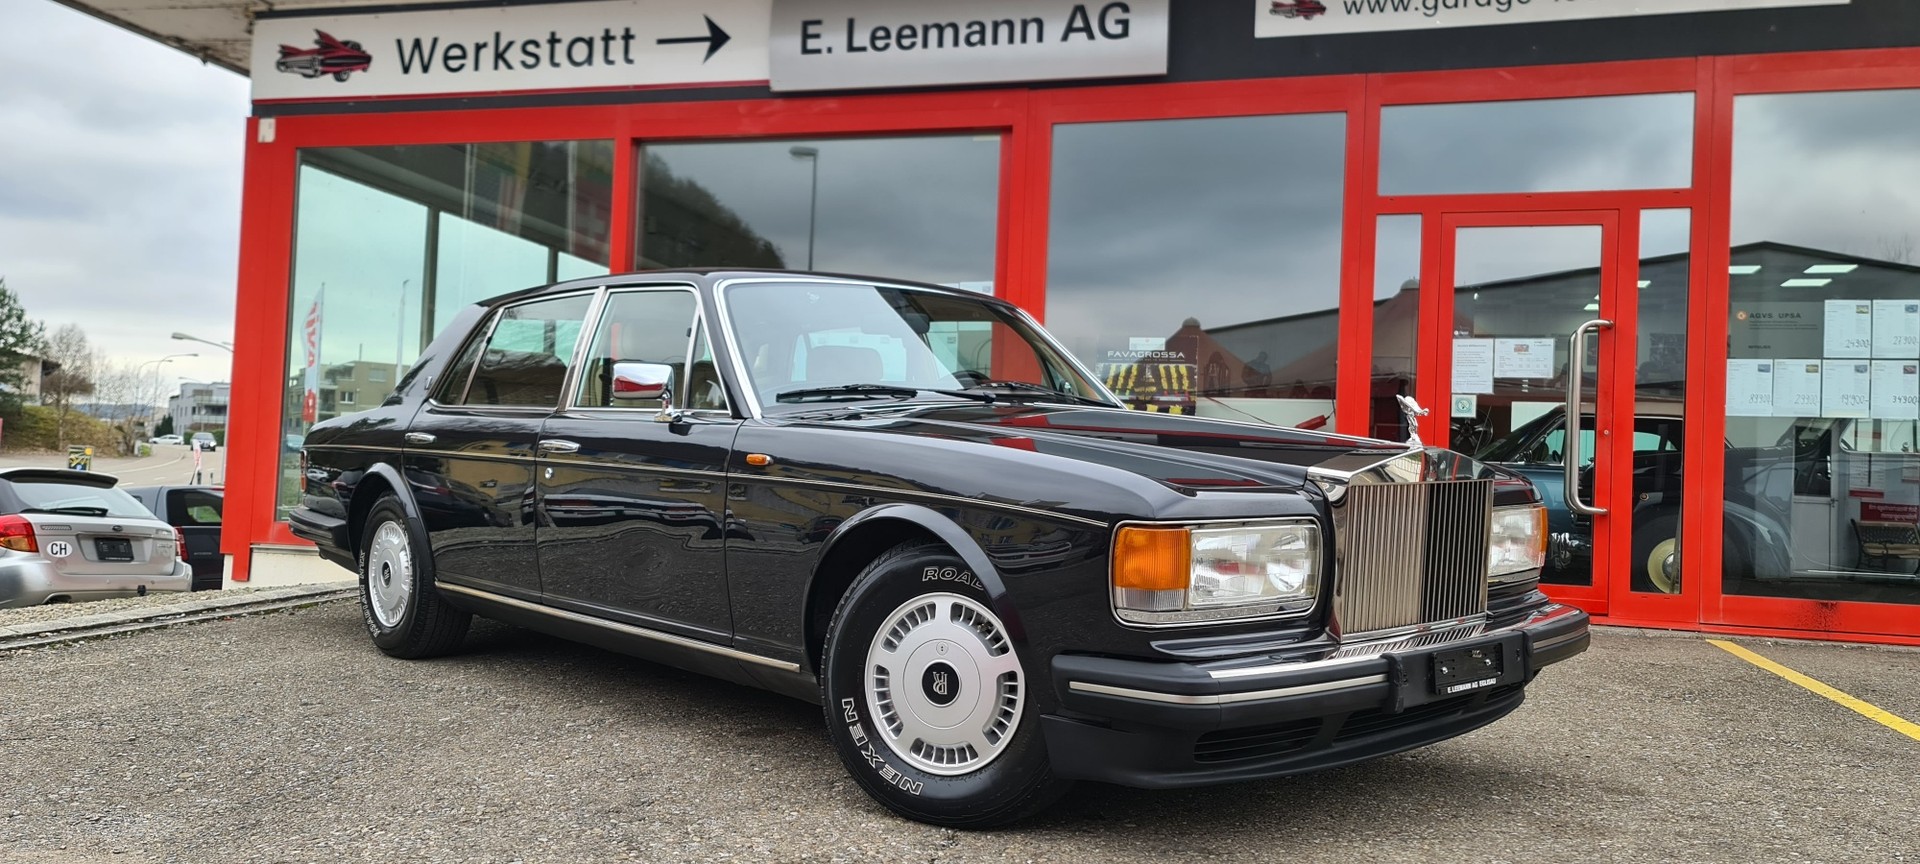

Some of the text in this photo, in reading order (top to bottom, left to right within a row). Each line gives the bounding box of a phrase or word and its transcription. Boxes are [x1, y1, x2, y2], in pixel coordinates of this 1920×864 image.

[396, 27, 636, 75] Werkstatt
[801, 1, 1131, 55] E. Leemann AG
[1107, 350, 1185, 359] FAVAGROSSA
[50, 543, 67, 556] CH
[842, 697, 924, 796] NEXEN
